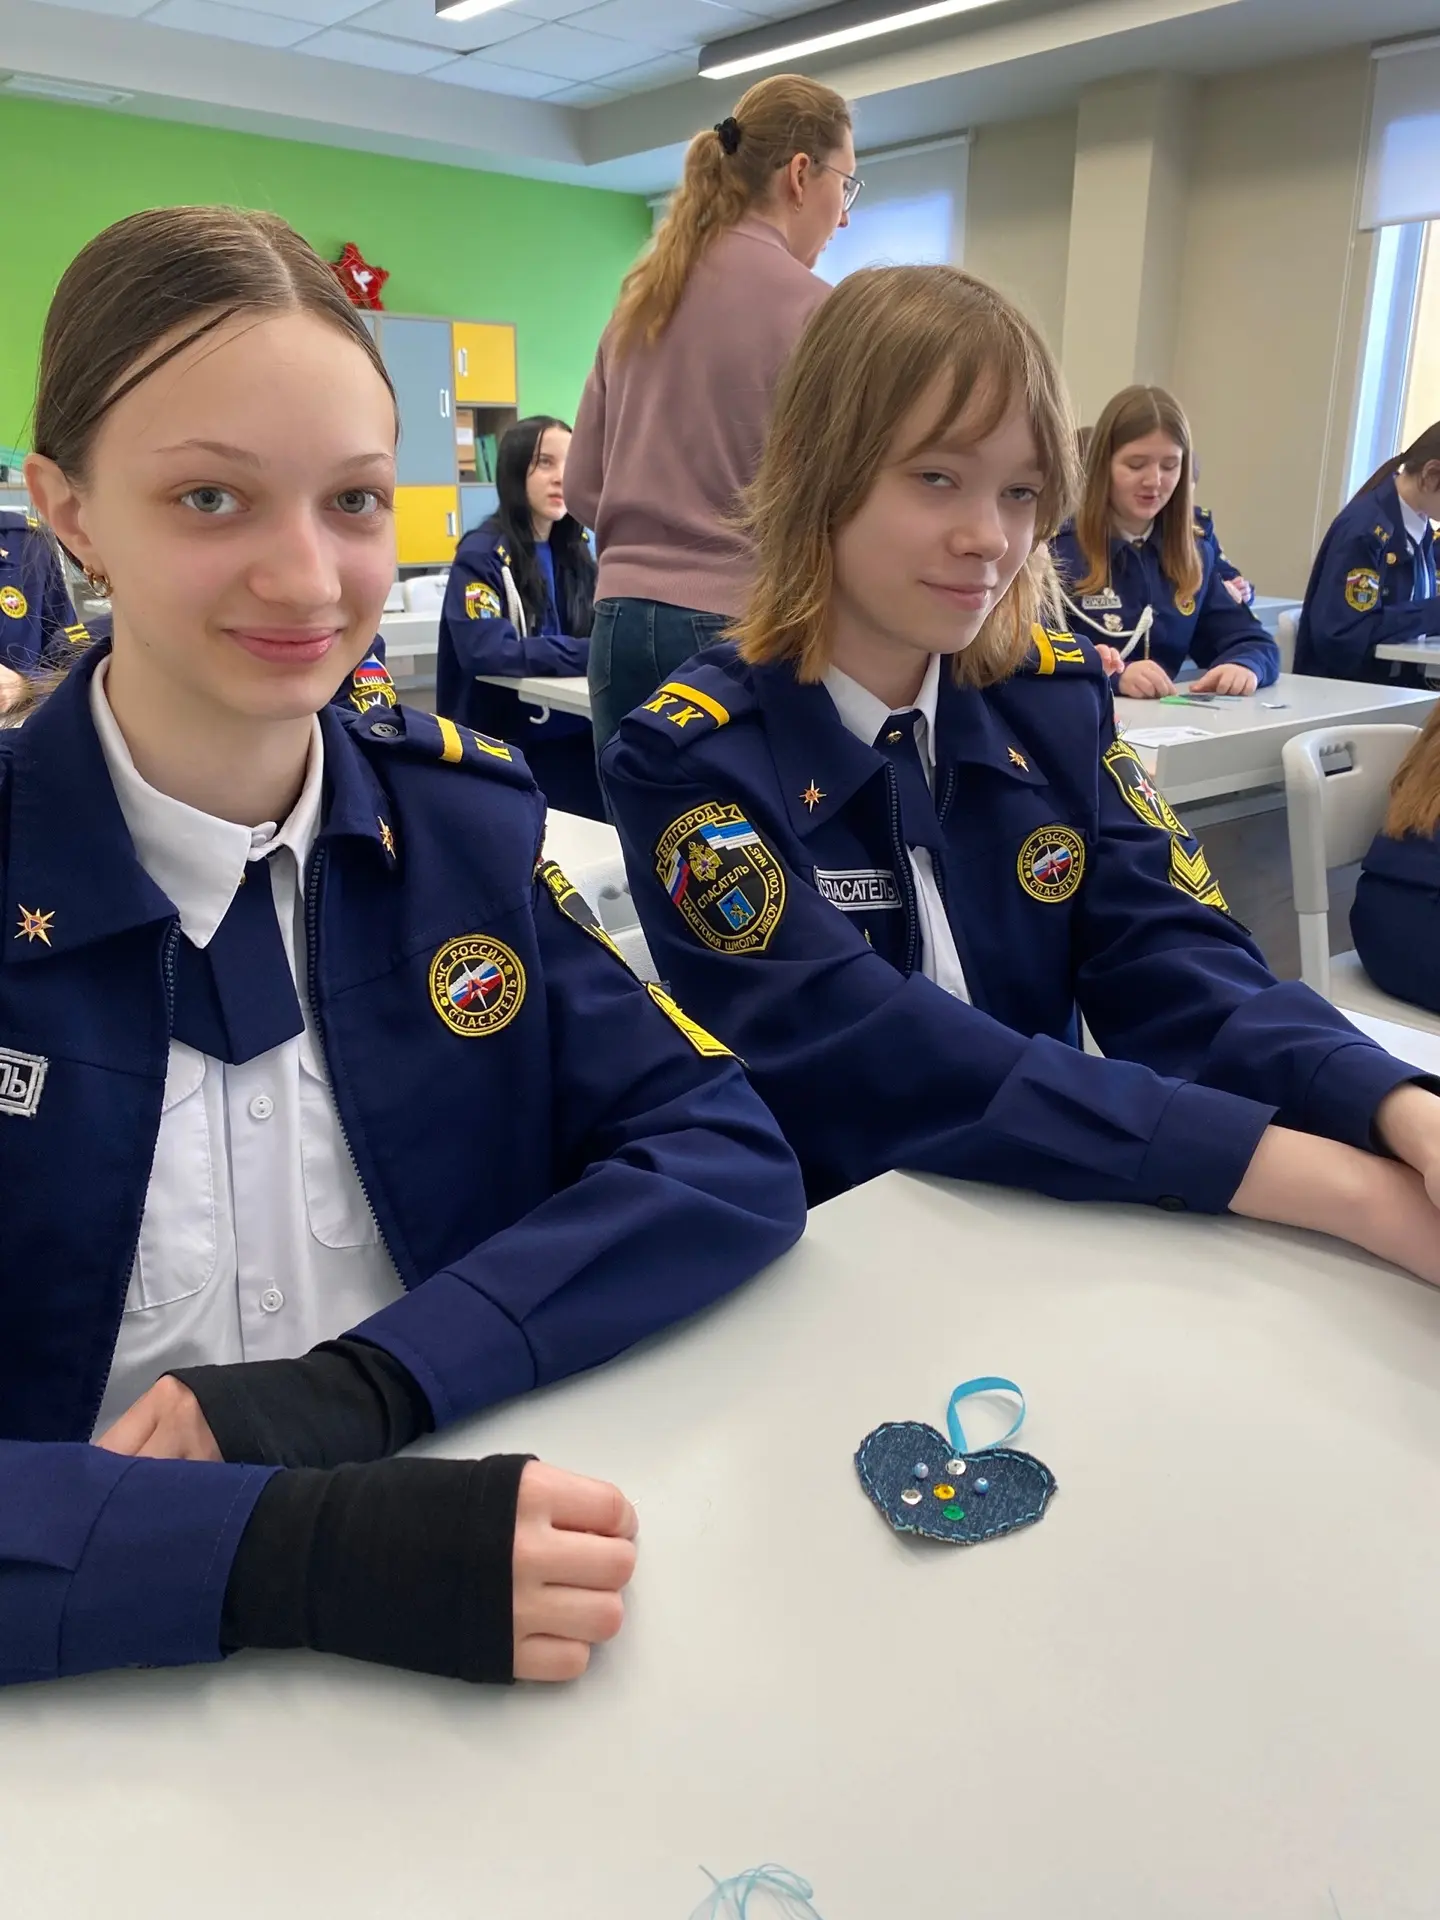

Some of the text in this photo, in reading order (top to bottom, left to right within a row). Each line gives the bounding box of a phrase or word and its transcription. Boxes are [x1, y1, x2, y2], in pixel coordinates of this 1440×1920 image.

[659, 806, 718, 859] БЕЛГОРОД
[1023, 832, 1077, 869] МЧС РОССИИ
[697, 864, 750, 909] СПАСАТЕЛЬ
[819, 878, 896, 901] СПАСАТЕЛЬ
[1029, 861, 1079, 896] СПАСАТЕЛЬ
[682, 900, 722, 948] КАДЕТСКАЯ
[724, 934, 760, 951] ШКОЛА
[758, 903, 778, 935] МБОУ
[436, 943, 507, 998] МЧС РОССИИ
[448, 979, 517, 1028] СПАСАТЕЛЬ
